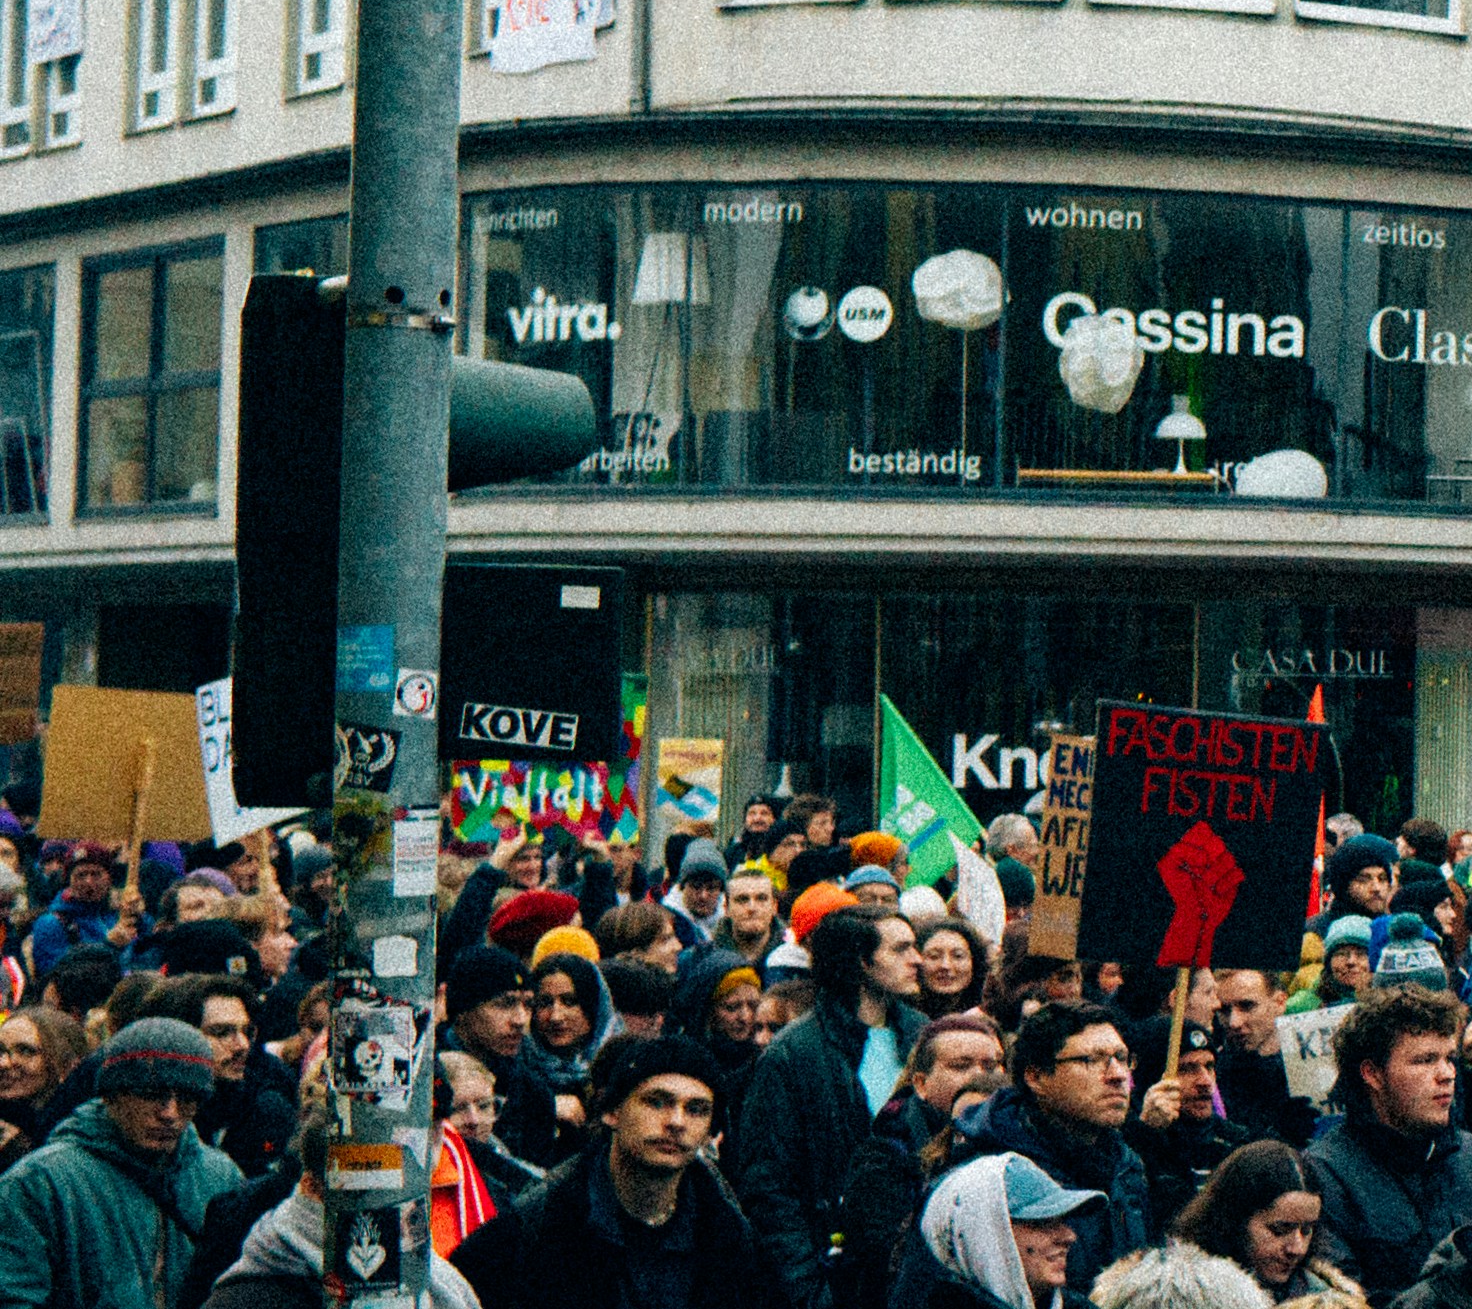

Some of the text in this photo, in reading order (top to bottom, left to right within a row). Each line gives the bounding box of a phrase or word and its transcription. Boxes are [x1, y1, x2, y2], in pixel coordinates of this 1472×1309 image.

[703, 200, 803, 224] modern
[1025, 203, 1143, 230] wohnen
[1362, 221, 1447, 250] zeitlos
[845, 306, 886, 322] USM
[848, 447, 982, 480] beständig
[462, 704, 577, 752] KOVE
[1106, 708, 1320, 774] FASCHISTEN
[1140, 765, 1277, 823] FISTEN
